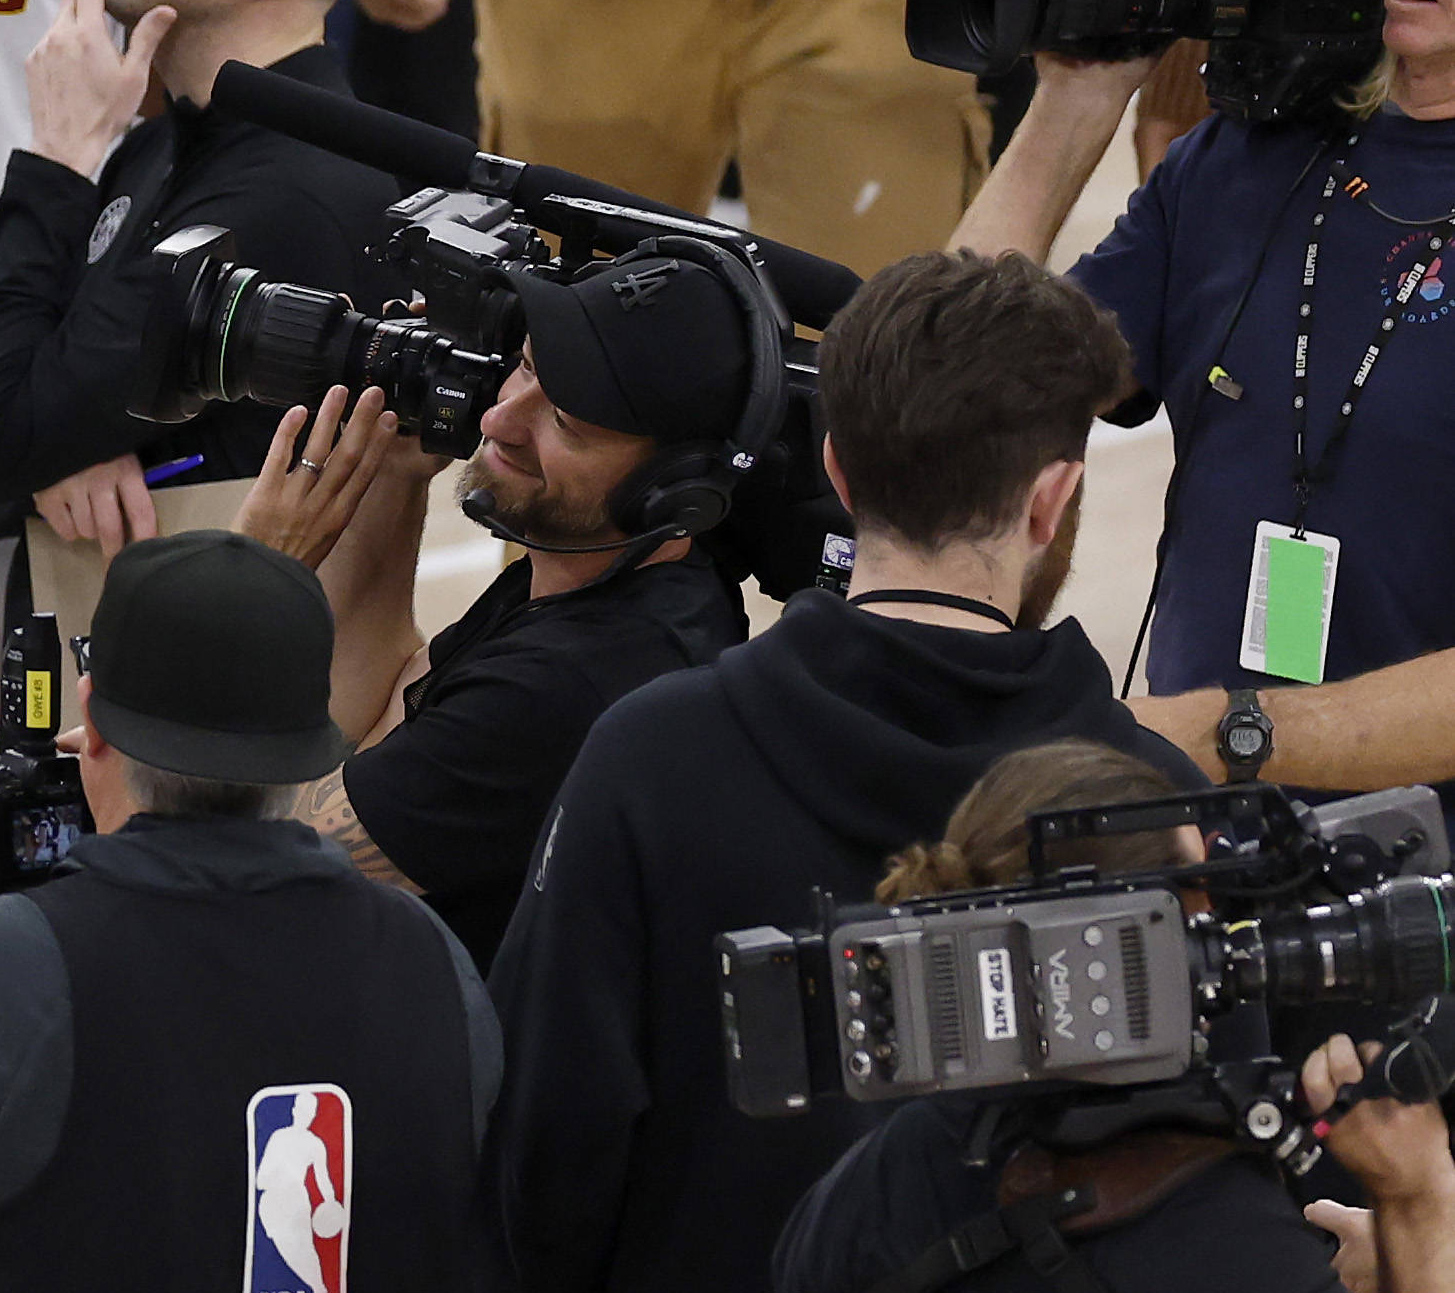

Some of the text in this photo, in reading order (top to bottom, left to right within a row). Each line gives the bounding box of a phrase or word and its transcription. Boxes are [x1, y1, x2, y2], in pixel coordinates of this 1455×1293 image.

[435, 386, 466, 400] Canon
[988, 953, 1009, 1035] STOP HATE
[1048, 948, 1076, 1040] AMIRA
